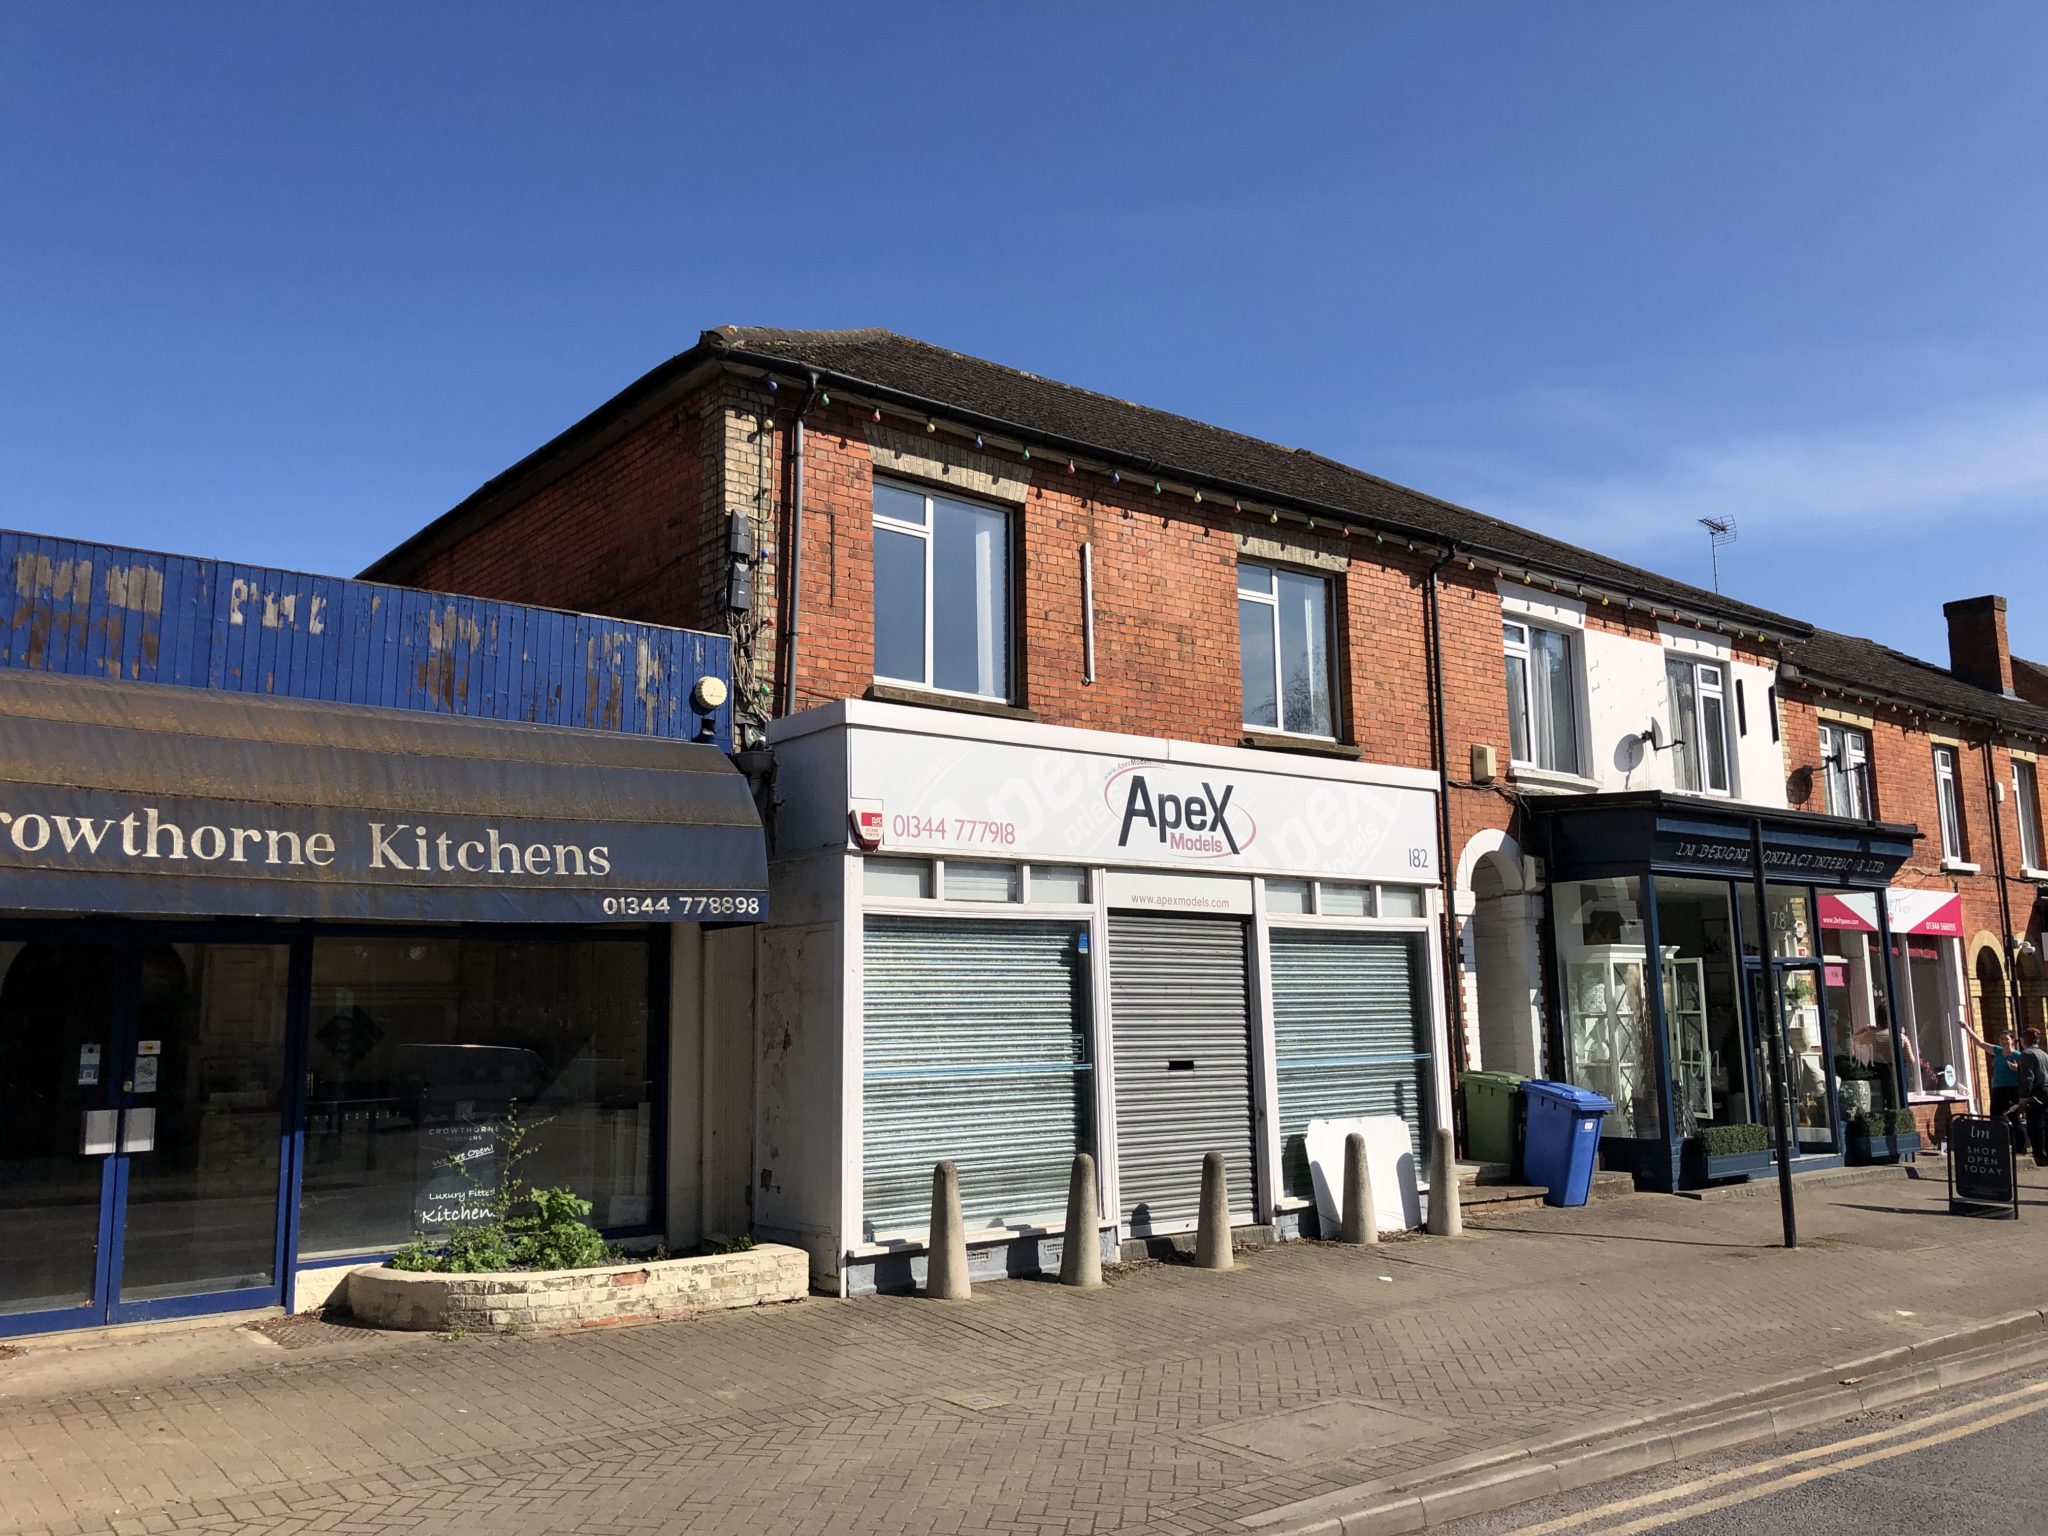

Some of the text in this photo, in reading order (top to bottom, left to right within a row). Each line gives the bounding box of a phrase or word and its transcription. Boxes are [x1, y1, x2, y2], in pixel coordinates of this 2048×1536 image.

[893, 814, 1015, 846] 01344 777918
[369, 823, 611, 876] Kitchens
[1170, 832, 1223, 853] Models
[1409, 848, 1429, 868] 182
[1698, 844, 1750, 862] DESIGNS
[1762, 850, 1811, 867] ONTRACT
[602, 896, 760, 917] 01344 778898
[1131, 894, 1230, 909] www.apexmodels.com
[428, 1125, 501, 1136] CROWTHORNE
[467, 1143, 495, 1159] Open!
[1967, 1146, 1997, 1156] SHOP
[1967, 1156, 1998, 1166] OPEN
[1964, 1165, 2002, 1176] TODAY
[428, 1190, 467, 1202] Luxury
